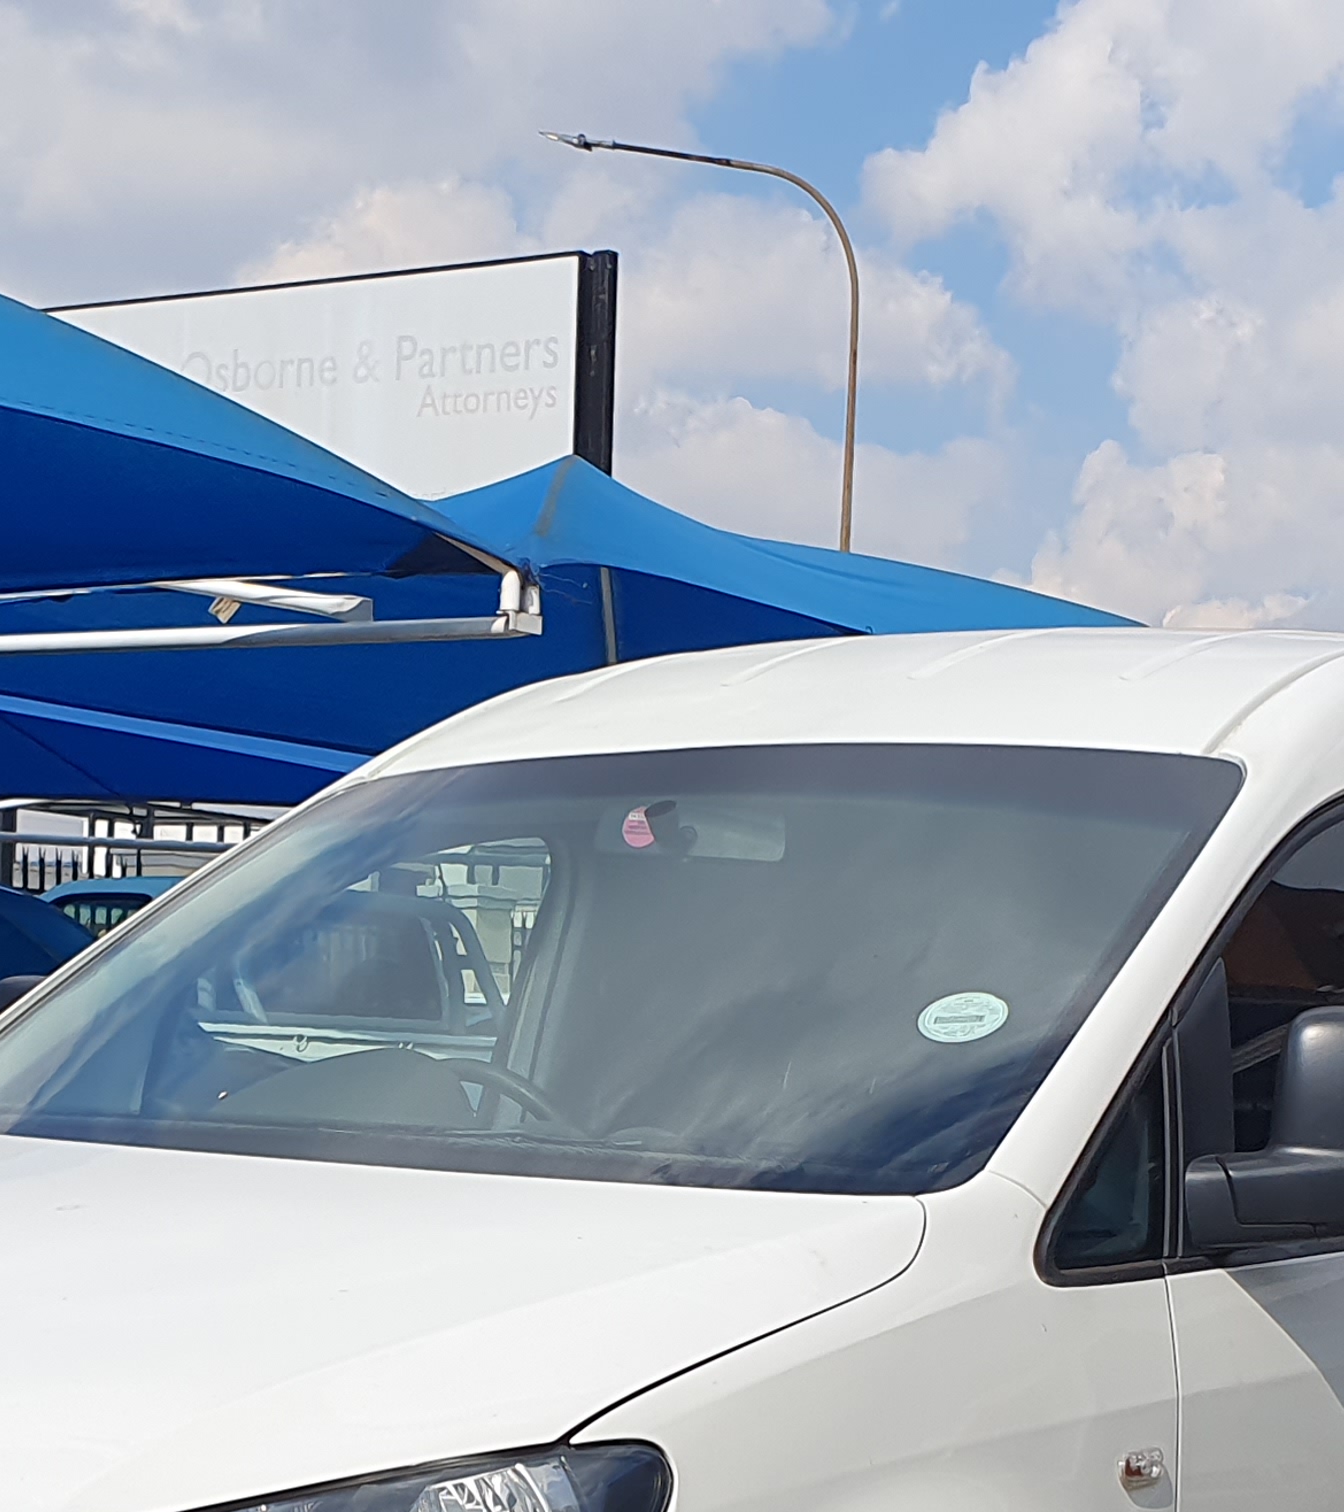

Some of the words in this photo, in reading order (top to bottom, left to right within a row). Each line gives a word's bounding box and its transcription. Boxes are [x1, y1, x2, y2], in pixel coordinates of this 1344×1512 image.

[182, 349, 338, 393] Osborne
[352, 338, 381, 385] &
[395, 335, 560, 382] Partners
[416, 383, 558, 421] Attorneys
